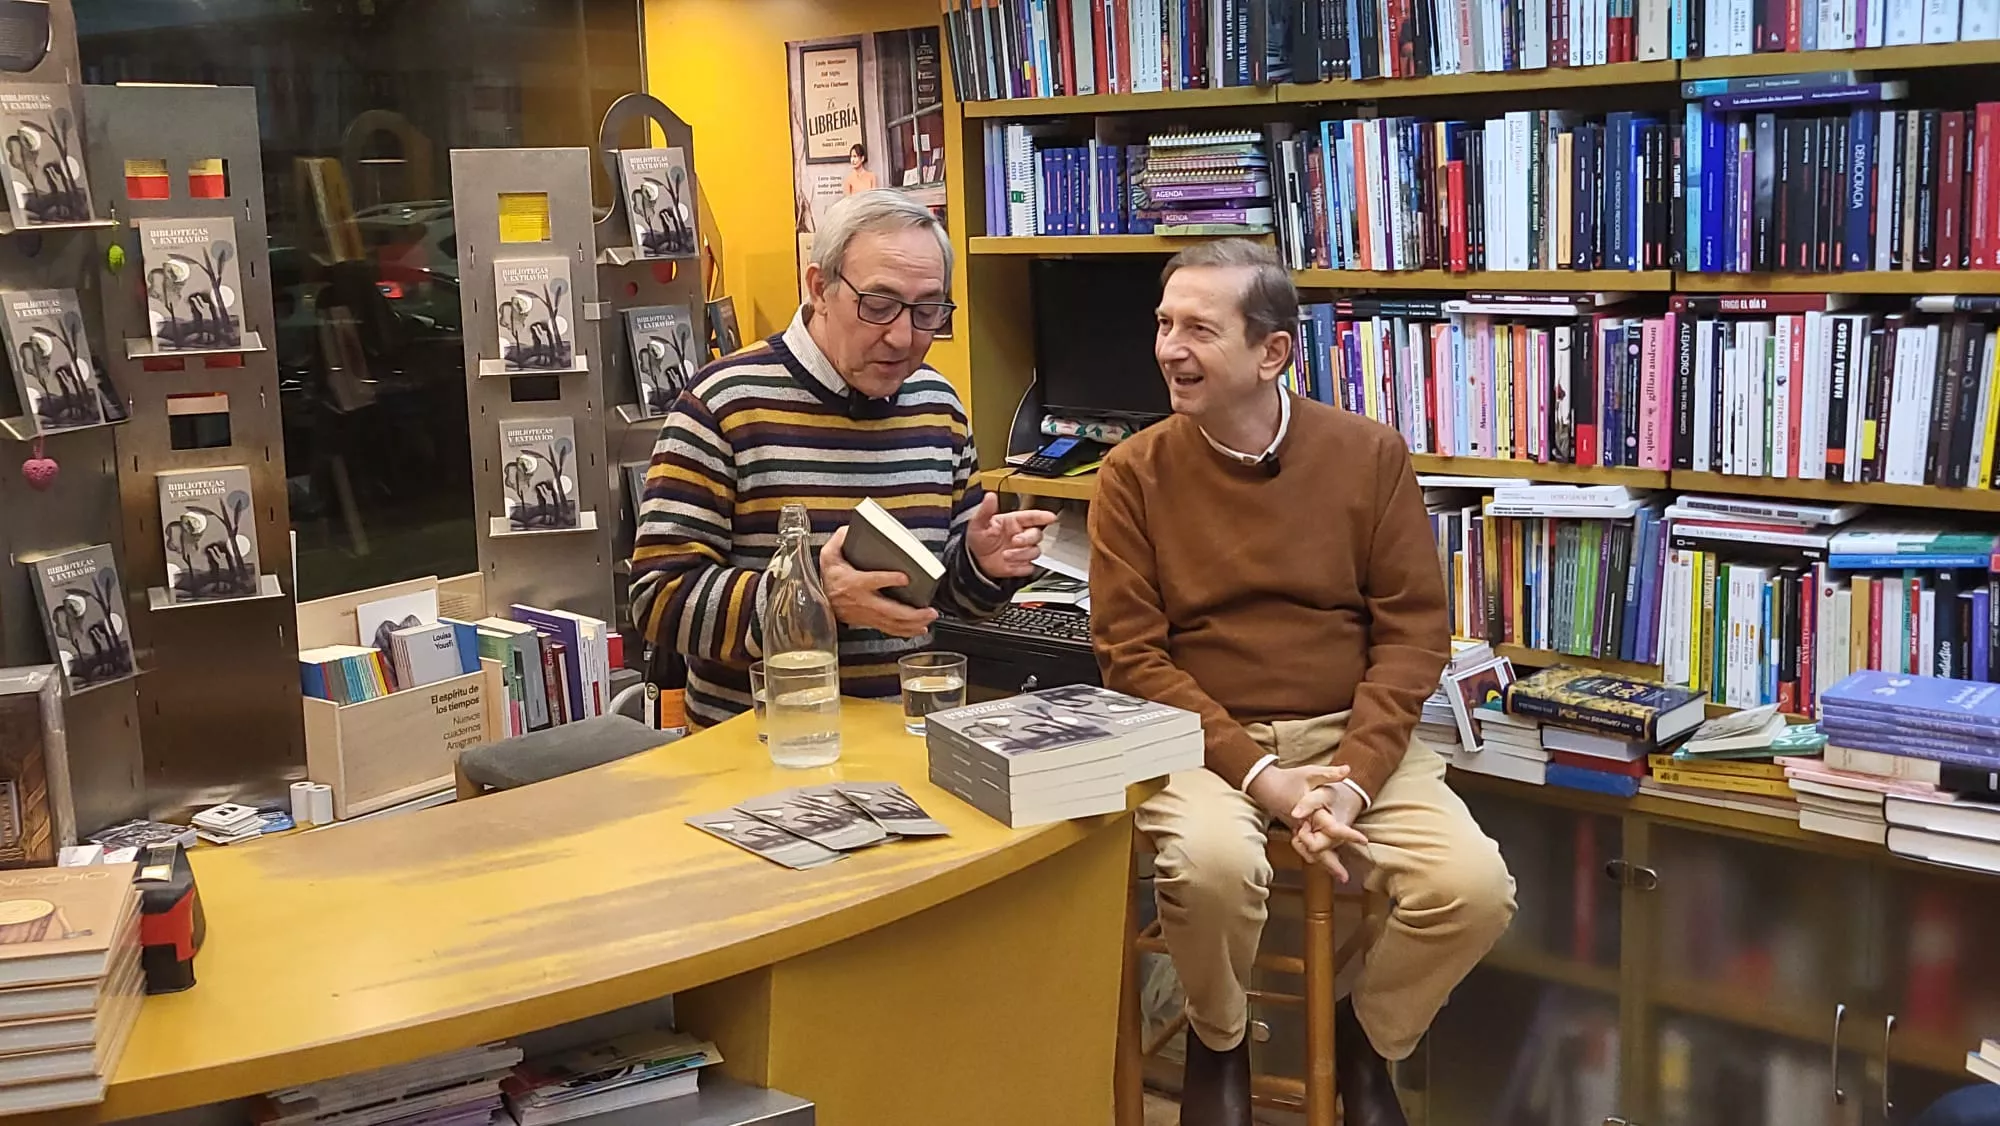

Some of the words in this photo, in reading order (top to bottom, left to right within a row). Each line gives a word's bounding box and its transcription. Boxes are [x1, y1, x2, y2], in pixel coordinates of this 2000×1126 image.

[808, 102, 858, 137] LIBRERÍA
[1852, 144, 1866, 209] DEMOCRACIA
[1156, 190, 1183, 198] AGENDA
[150, 228, 208, 237] BIBLIOTECAS
[1721, 300, 1740, 309] TRIGO
[1740, 299, 1748, 309] EL
[1749, 298, 1760, 310] DÍA
[1647, 326, 1656, 370] anderson
[1680, 322, 1690, 376] ALEJANDRO
[1836, 323, 1847, 360] FUEGO
[1646, 371, 1656, 402] gillian
[1834, 361, 1845, 398] HABRÁ
[507, 428, 553, 437] BIBLIOTECAS
[1646, 421, 1656, 452] quiero
[168, 480, 226, 491] BIBLIOTECAS
[432, 632, 452, 642] Louisa
[434, 640, 454, 650] Yousfi
[431, 695, 438, 704] El
[439, 688, 468, 702] espíritu
[468, 684, 479, 694] de
[436, 704, 448, 714] los
[448, 696, 480, 710] tiempos
[452, 713, 480, 725] Nuevos
[443, 724, 481, 740] cuadernos
